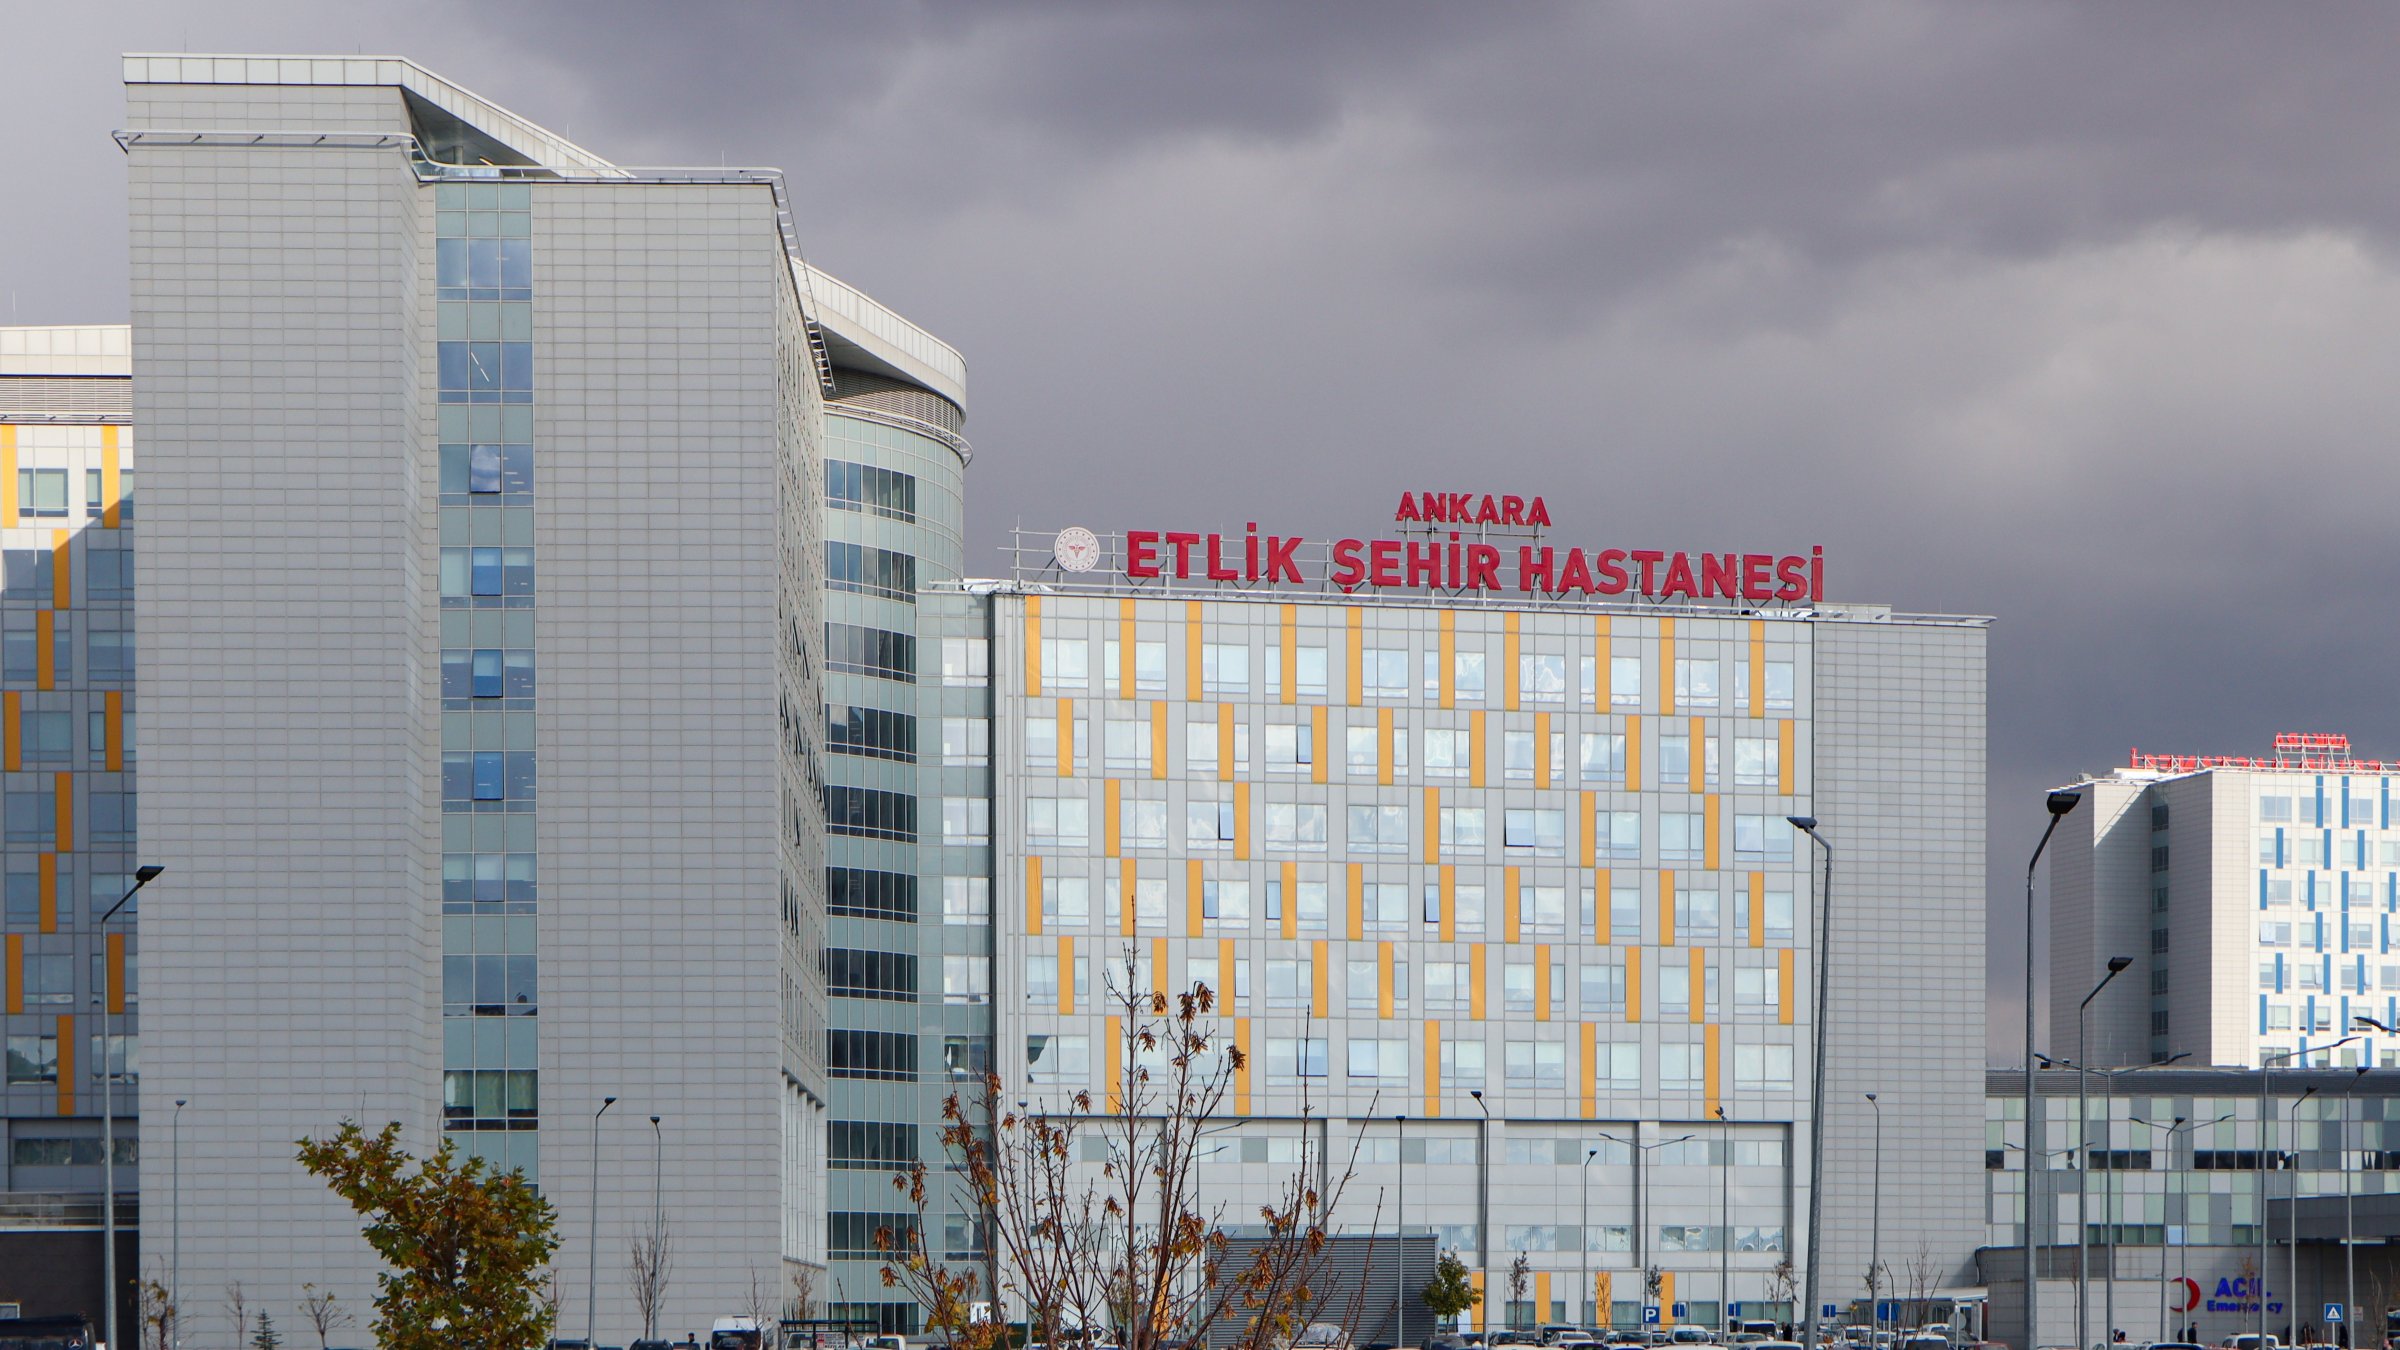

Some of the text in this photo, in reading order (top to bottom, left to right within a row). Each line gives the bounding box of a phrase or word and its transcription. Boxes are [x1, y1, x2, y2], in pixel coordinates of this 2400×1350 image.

[1395, 491, 1552, 527] ANKARA
[1127, 522, 1824, 602] ETLİK ŞEHİR HASTANESİ
[1645, 1308, 1657, 1322] P
[2206, 1299, 2284, 1315] Emerecy
